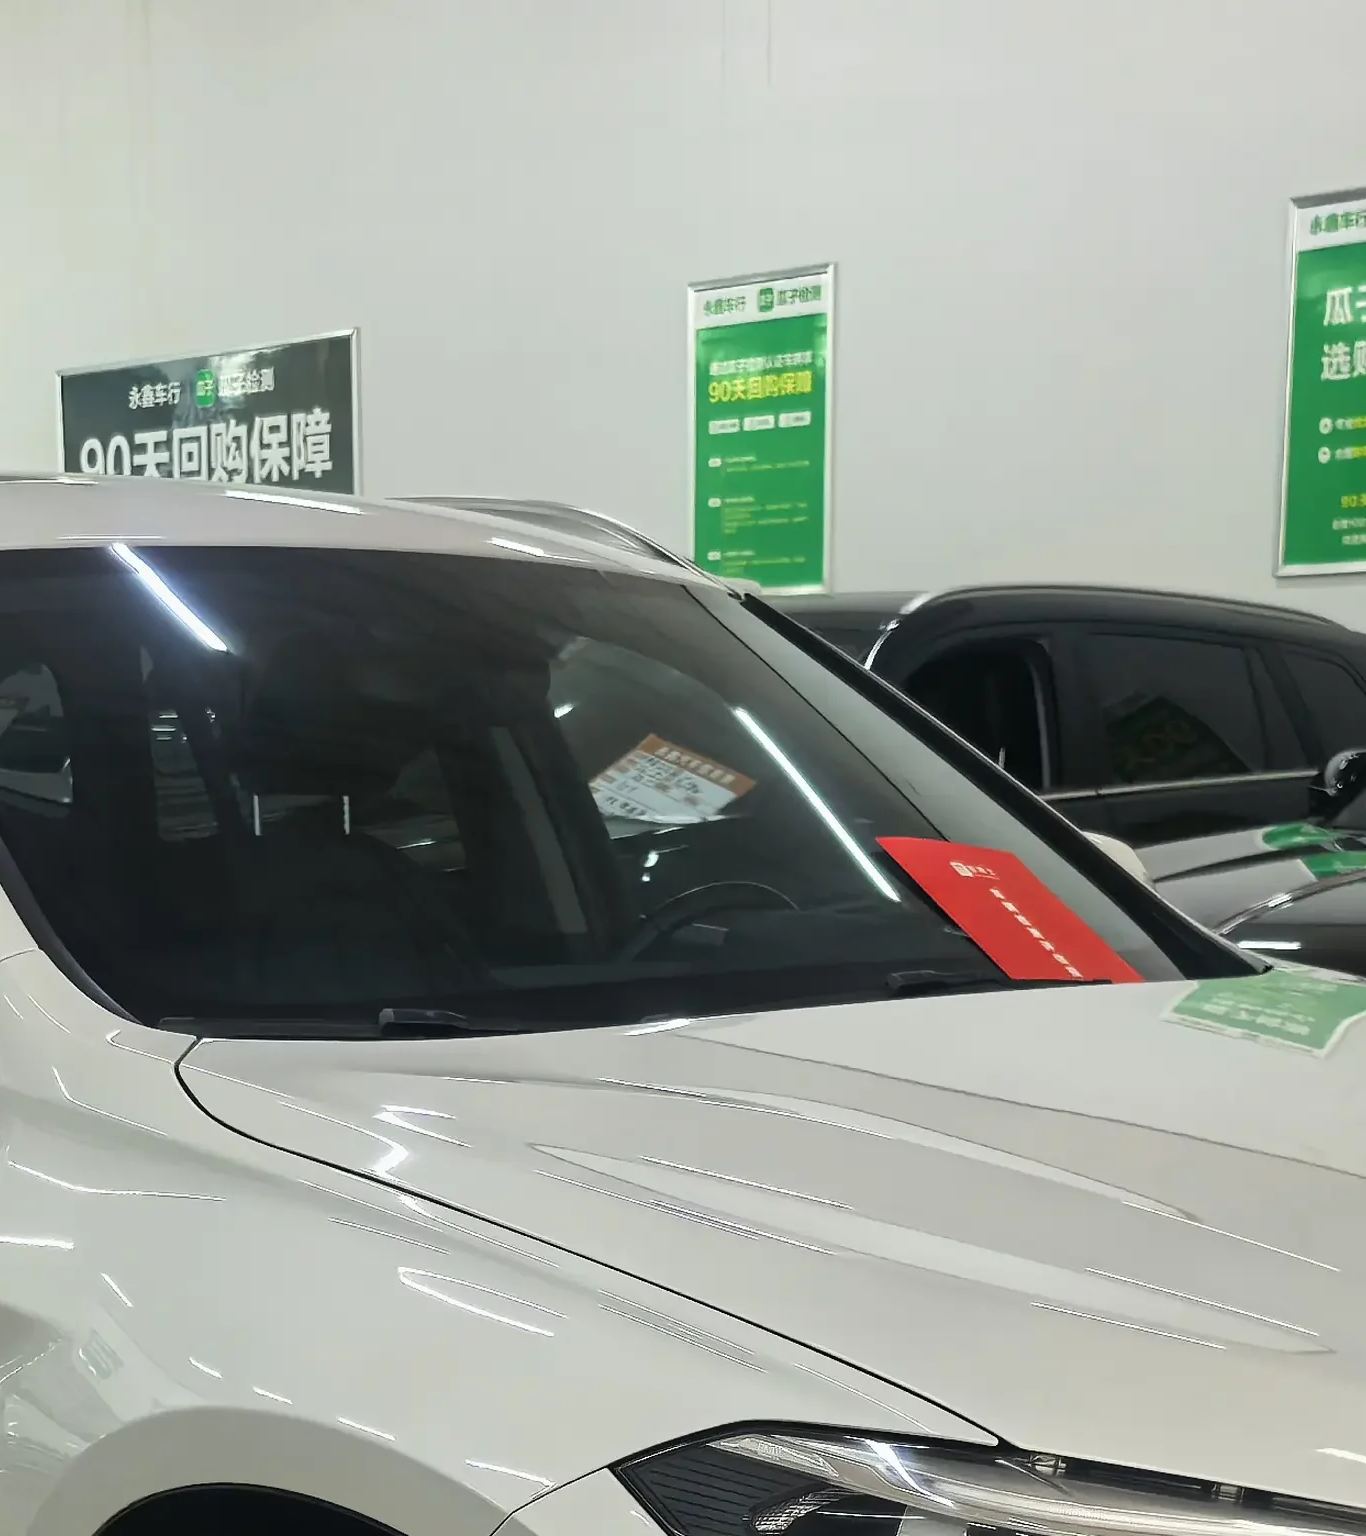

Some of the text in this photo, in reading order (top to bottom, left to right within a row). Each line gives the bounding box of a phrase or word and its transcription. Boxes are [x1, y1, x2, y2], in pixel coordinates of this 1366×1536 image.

[80, 404, 334, 484] 90天回购保障
